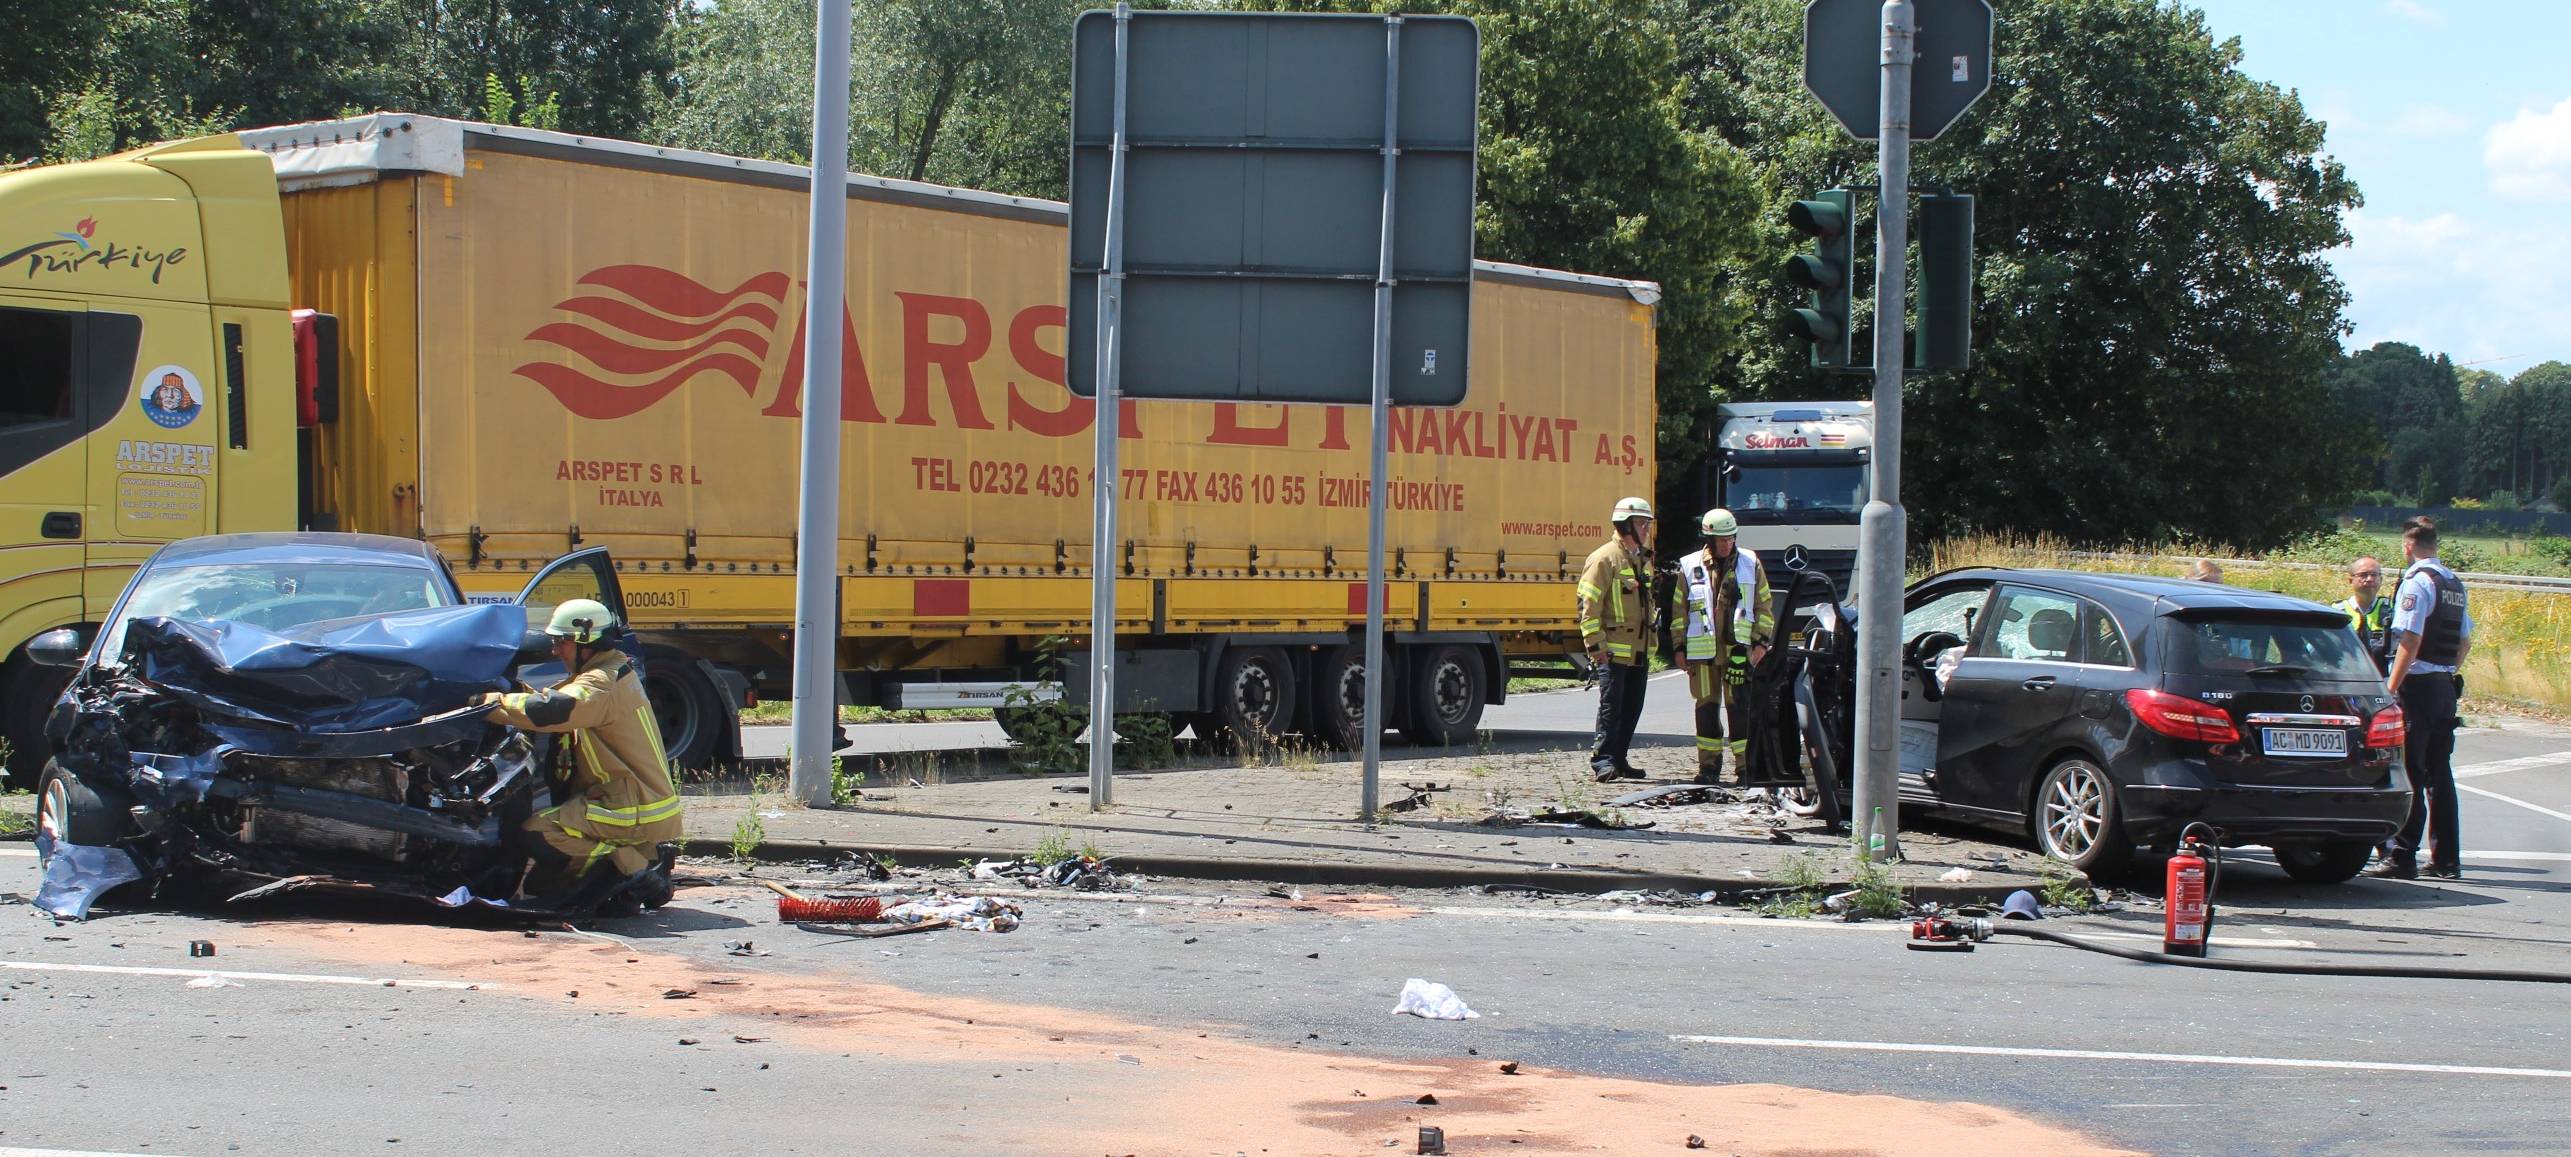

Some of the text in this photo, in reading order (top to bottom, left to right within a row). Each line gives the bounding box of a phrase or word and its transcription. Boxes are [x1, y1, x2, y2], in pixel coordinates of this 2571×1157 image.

[0, 240, 187, 284] Türkiye
[1387, 402, 1577, 463] NAKLİYAT
[1594, 433, 1644, 475] A.Ş.
[1745, 434, 1811, 449] Selman
[116, 439, 214, 466] ARSPET
[556, 460, 702, 485] ARSPET S R L
[911, 457, 961, 492] TEL
[969, 460, 1028, 495] 0232
[1036, 464, 1079, 498] 436
[1122, 469, 1148, 500] 77
[1156, 470, 1198, 502] FAX
[1205, 472, 1243, 504] 436
[1250, 474, 1274, 504] 10
[1281, 476, 1305, 505] 55
[1386, 475, 1464, 511] TÜRKİYE
[600, 485, 664, 507] İTALYA
[1501, 520, 1602, 540] www.arspet.com
[626, 591, 676, 608] 000043
[2442, 590, 2465, 607] POLIZE
[2272, 732, 2343, 750] AC MD 9091
